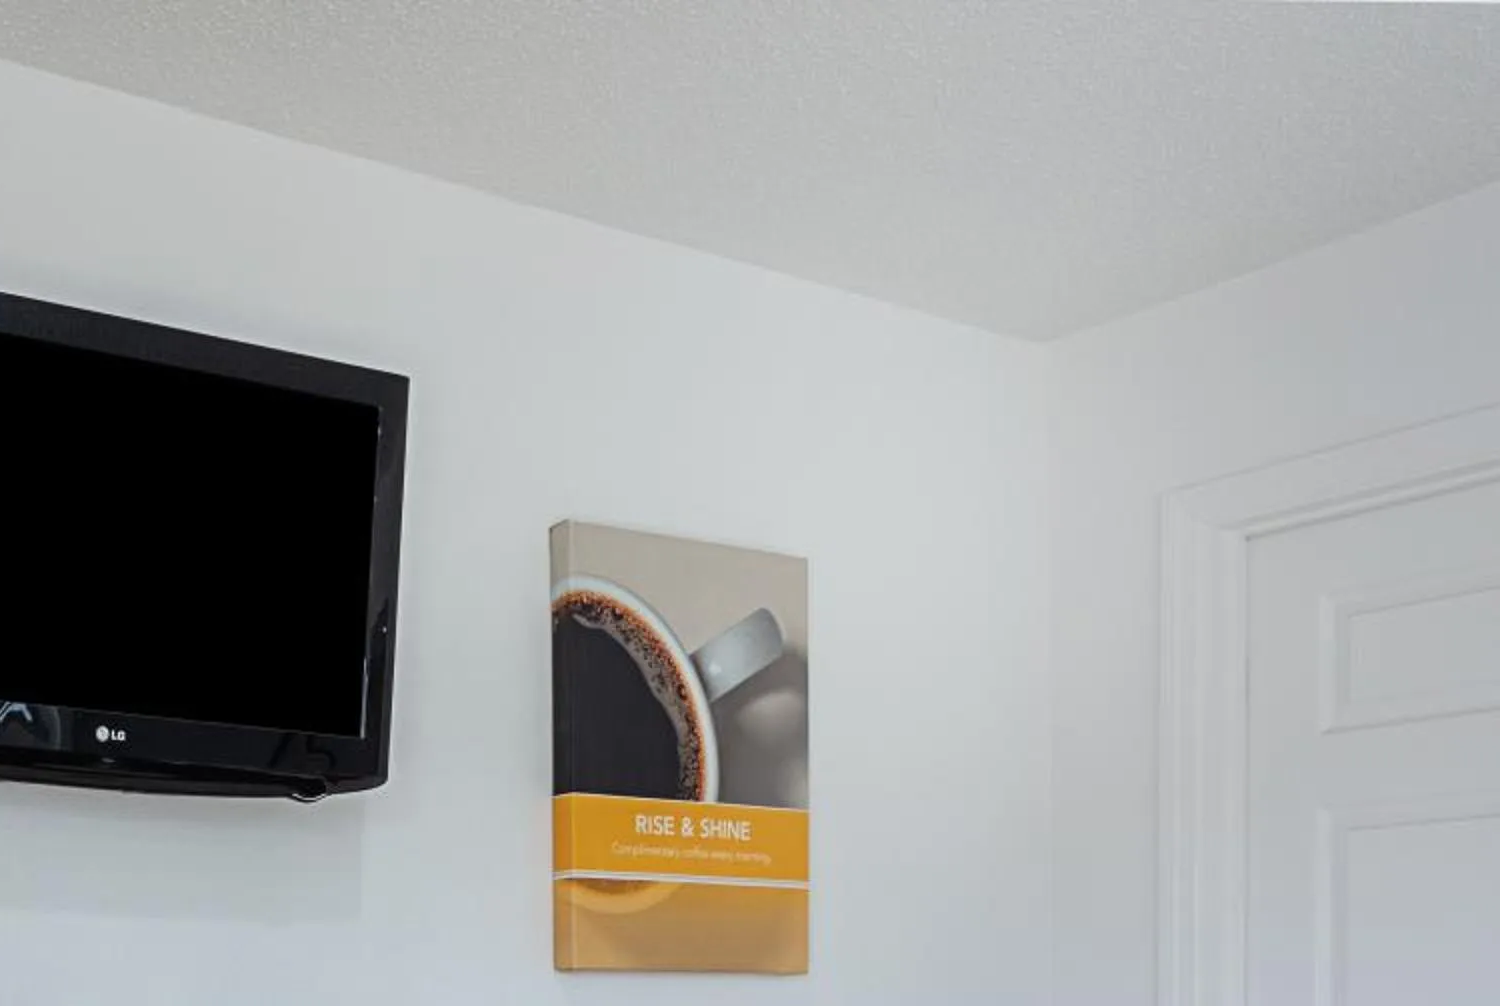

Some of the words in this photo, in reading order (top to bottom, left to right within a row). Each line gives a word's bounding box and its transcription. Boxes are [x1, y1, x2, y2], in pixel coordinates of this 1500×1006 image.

[635, 814, 676, 836] RISE
[681, 816, 694, 838] &
[700, 817, 752, 841] SHINE
